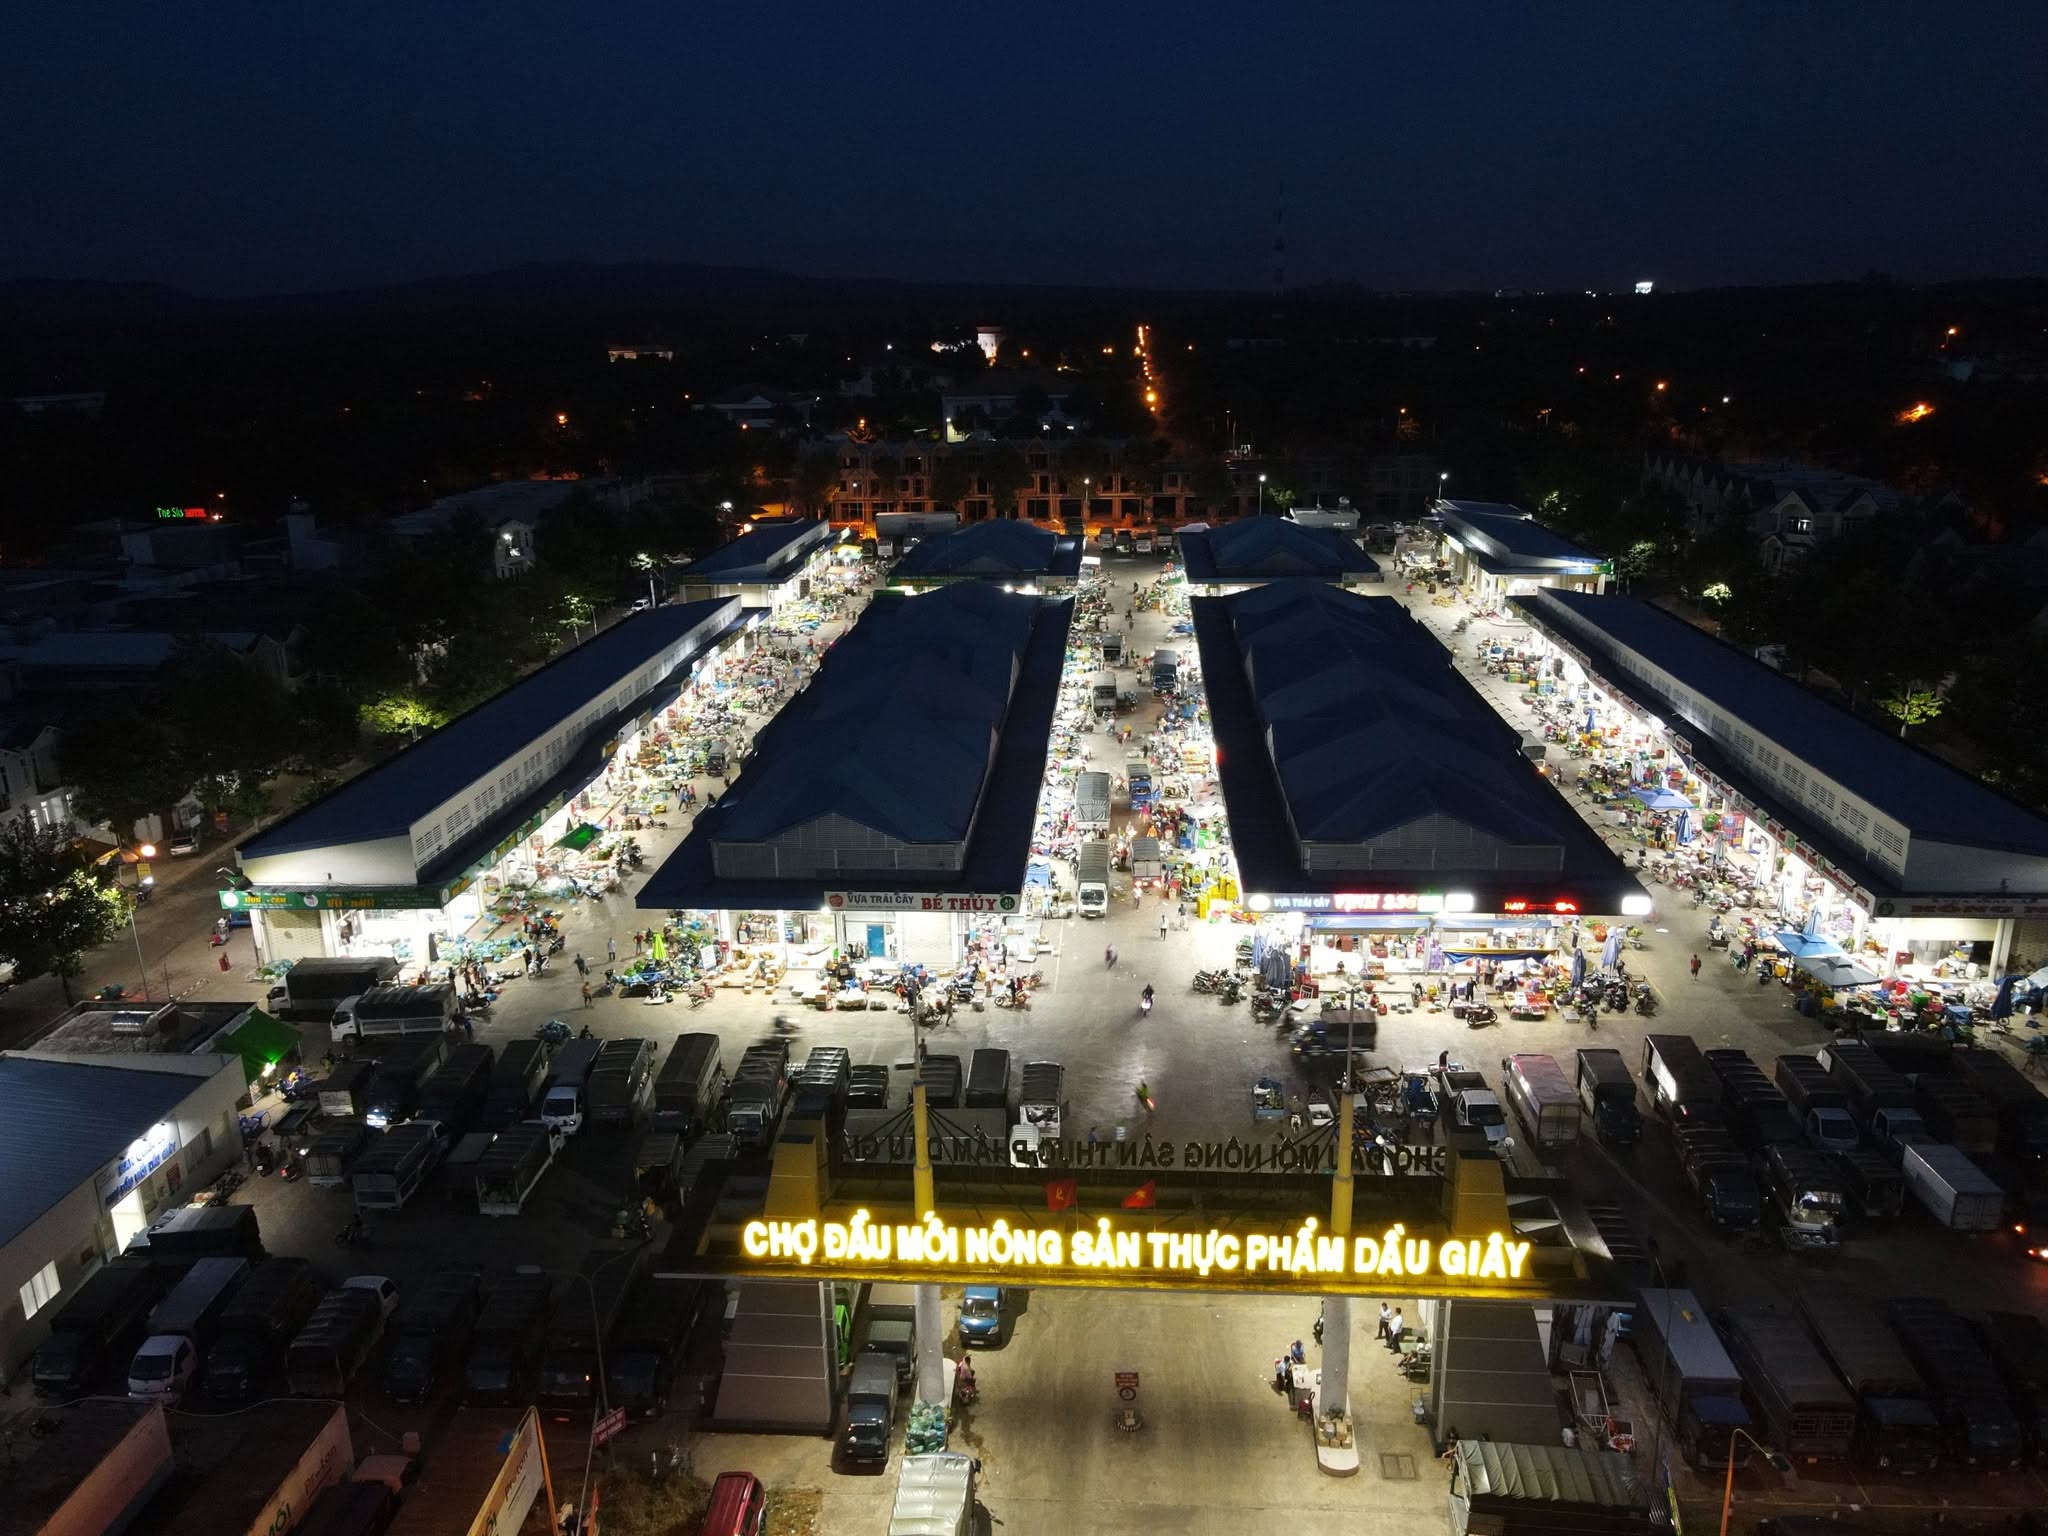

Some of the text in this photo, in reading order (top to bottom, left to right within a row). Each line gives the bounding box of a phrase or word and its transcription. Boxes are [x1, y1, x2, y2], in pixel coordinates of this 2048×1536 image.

[921, 895, 998, 911] BÉ THÚY
[743, 1209, 1530, 1278] CHỢ ĐẦU MỐI NÔNG SẢN THỰC PHẨM DẦU GIÂY
